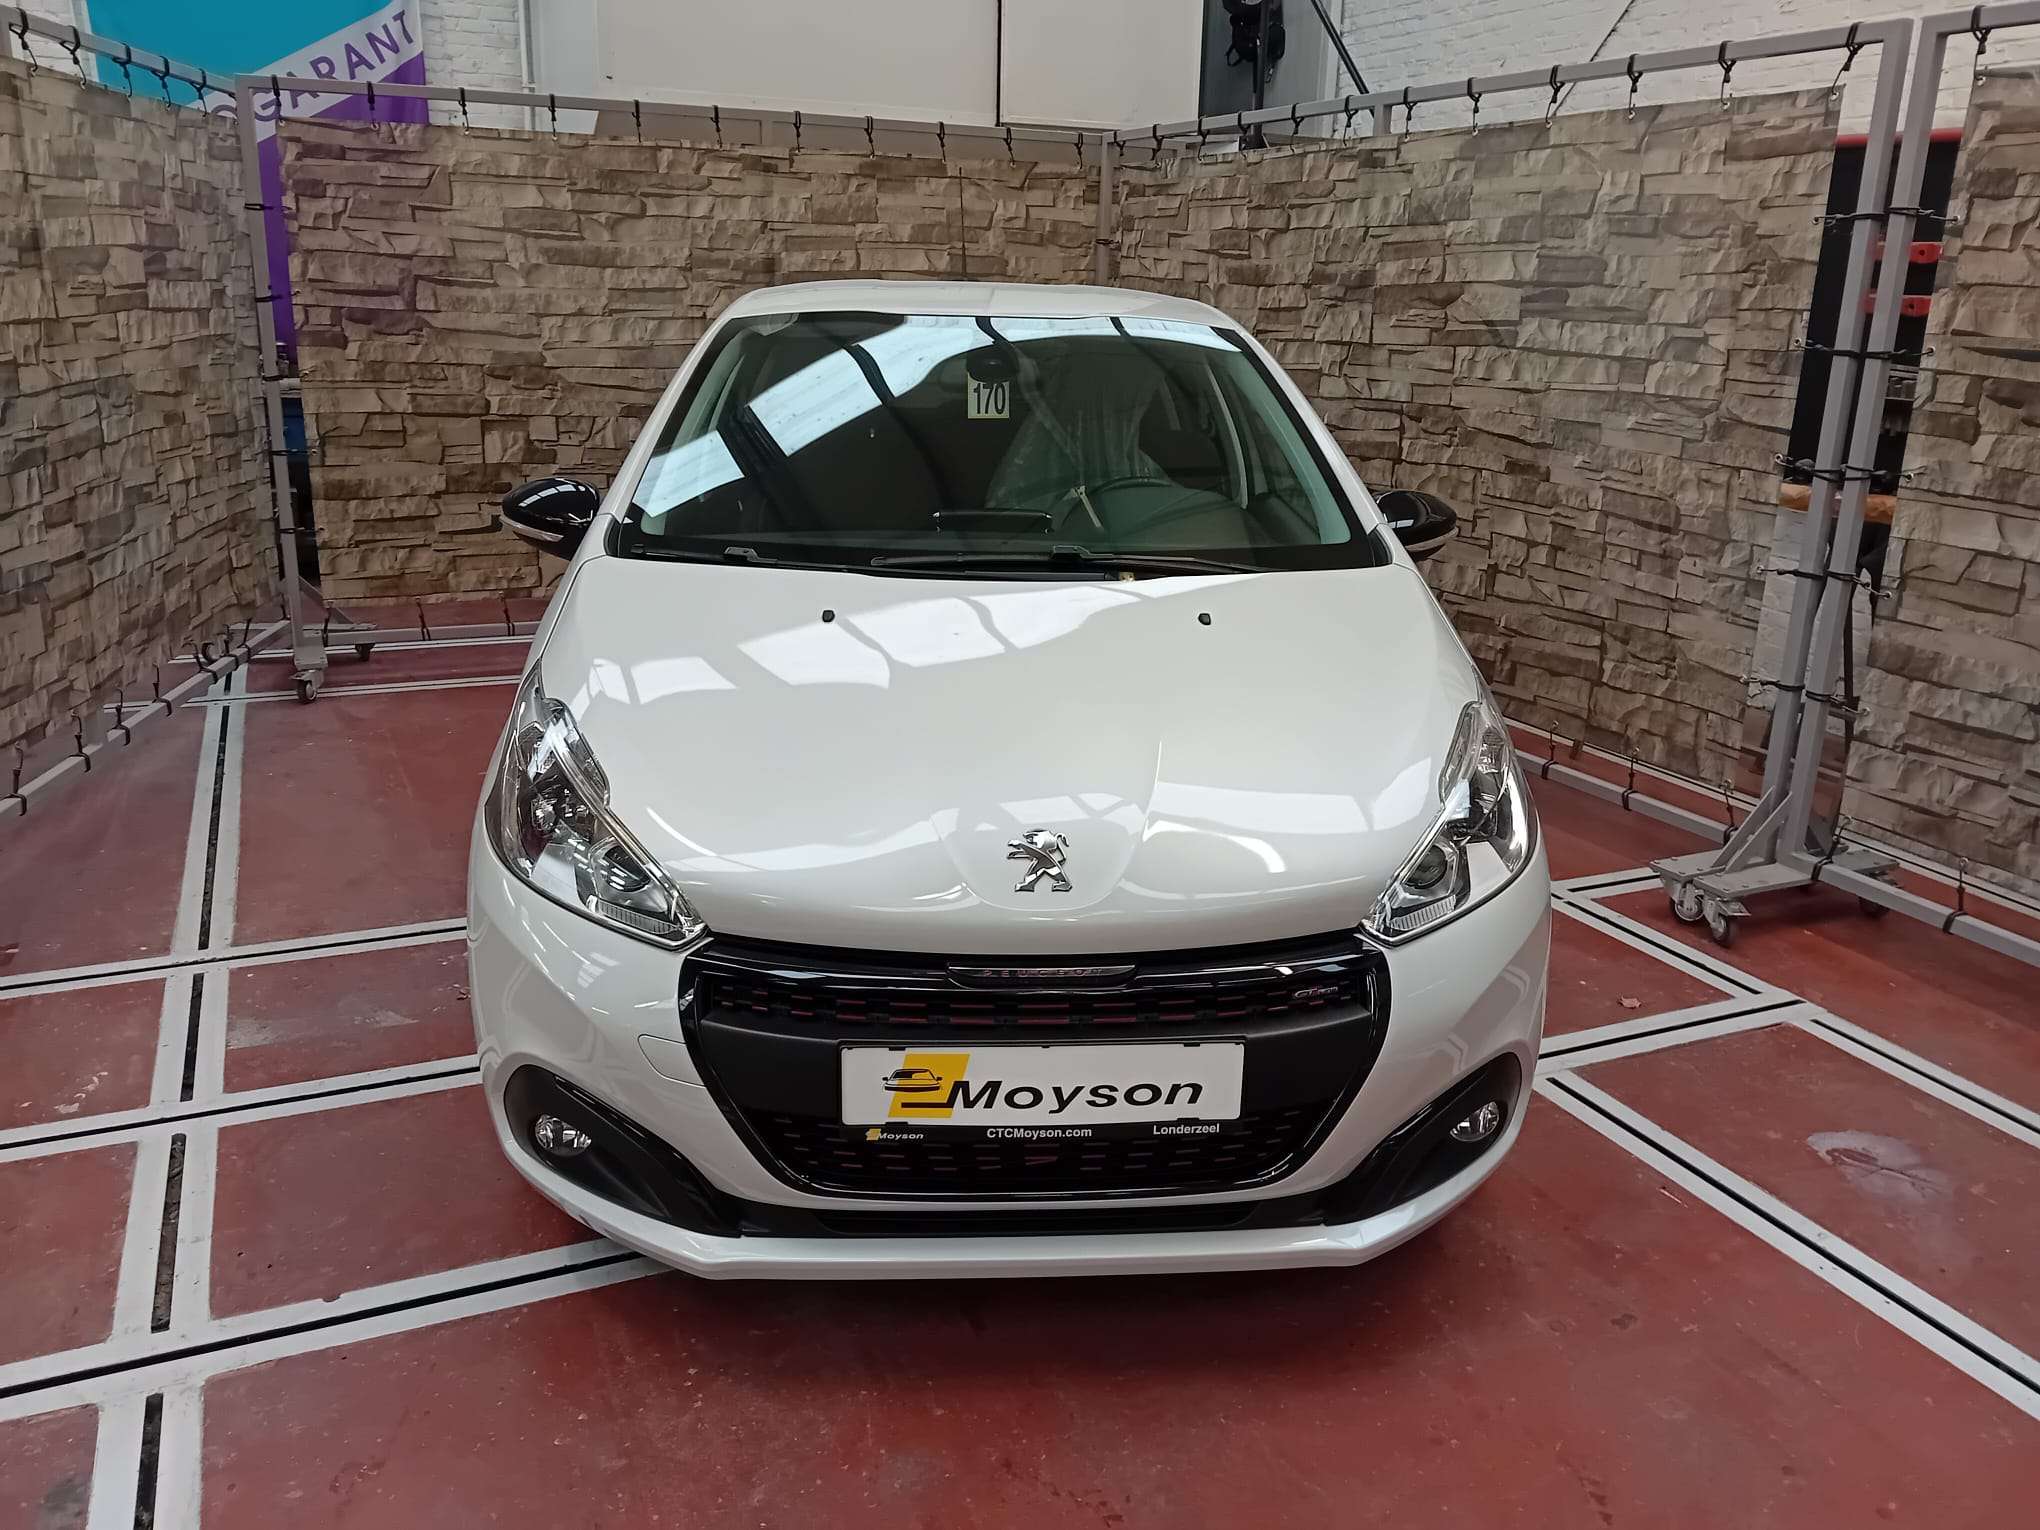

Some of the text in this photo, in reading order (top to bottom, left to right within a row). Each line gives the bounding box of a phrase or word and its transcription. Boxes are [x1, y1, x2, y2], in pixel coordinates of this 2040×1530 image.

[973, 382, 1006, 415] 170
[949, 1079, 1204, 1115] Moyson
[878, 1132, 924, 1141] Moyson
[986, 1126, 1092, 1140] CTCMoyson.com
[1153, 1123, 1220, 1136] Londerzeel
